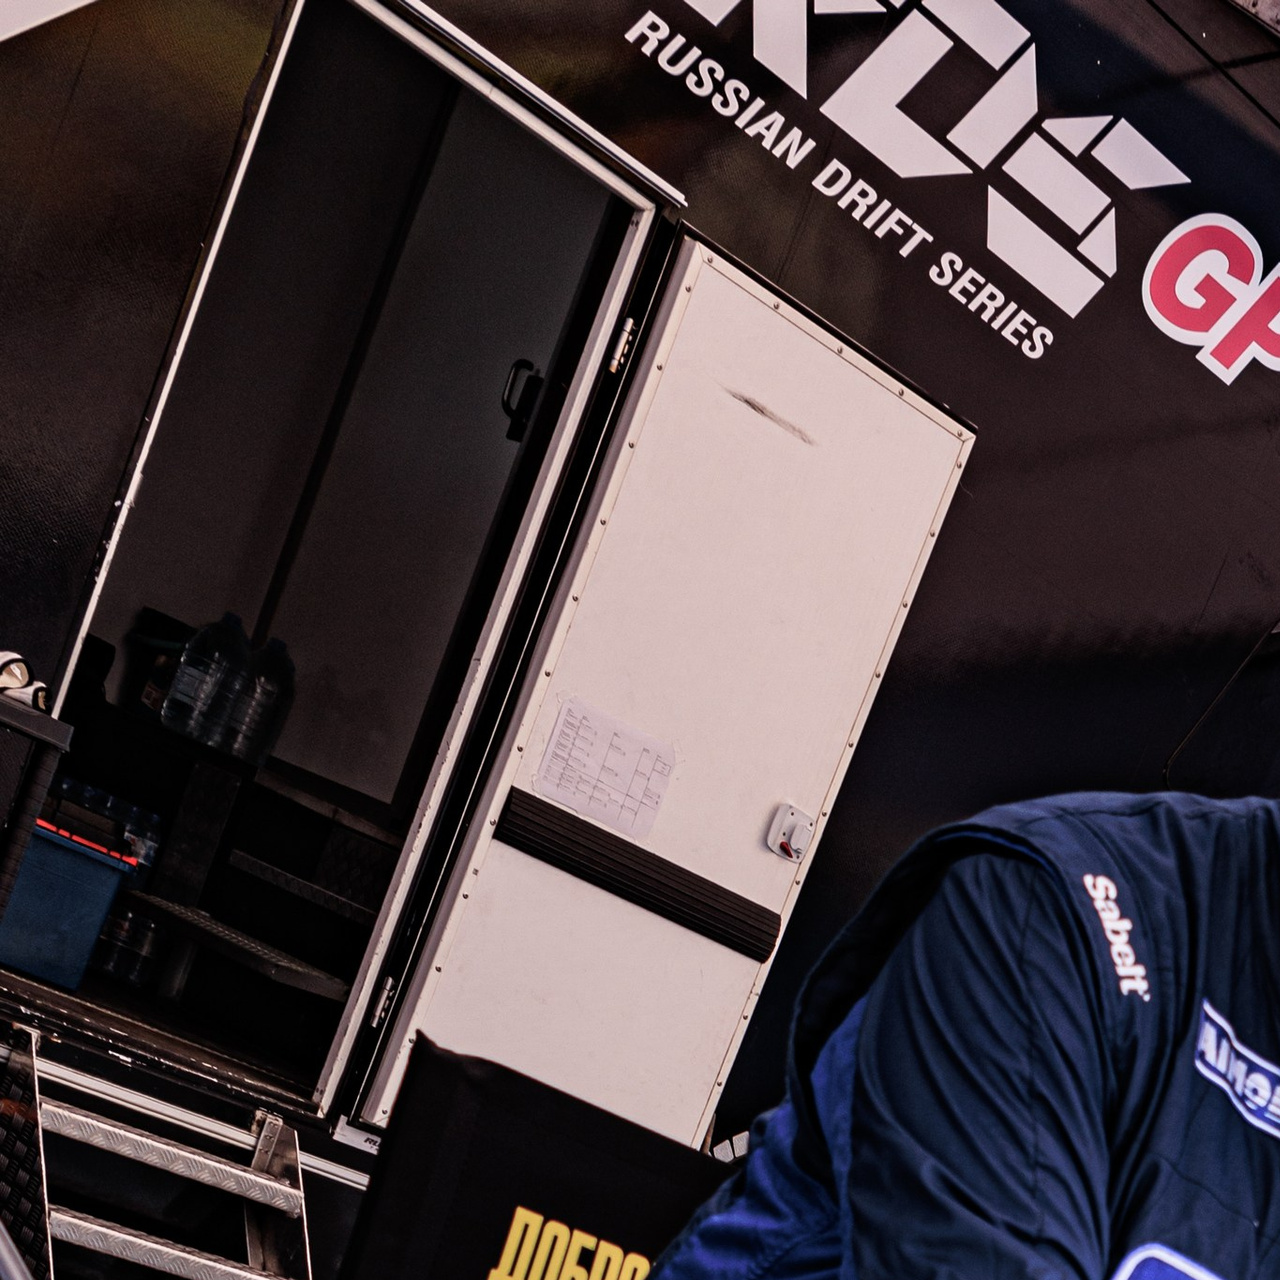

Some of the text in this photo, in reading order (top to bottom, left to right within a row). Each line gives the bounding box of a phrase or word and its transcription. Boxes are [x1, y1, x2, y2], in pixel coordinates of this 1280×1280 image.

[623, 9, 1056, 361] RUSSIAN DRIFT SERIES
[1083, 873, 1150, 1002] Sabelt
